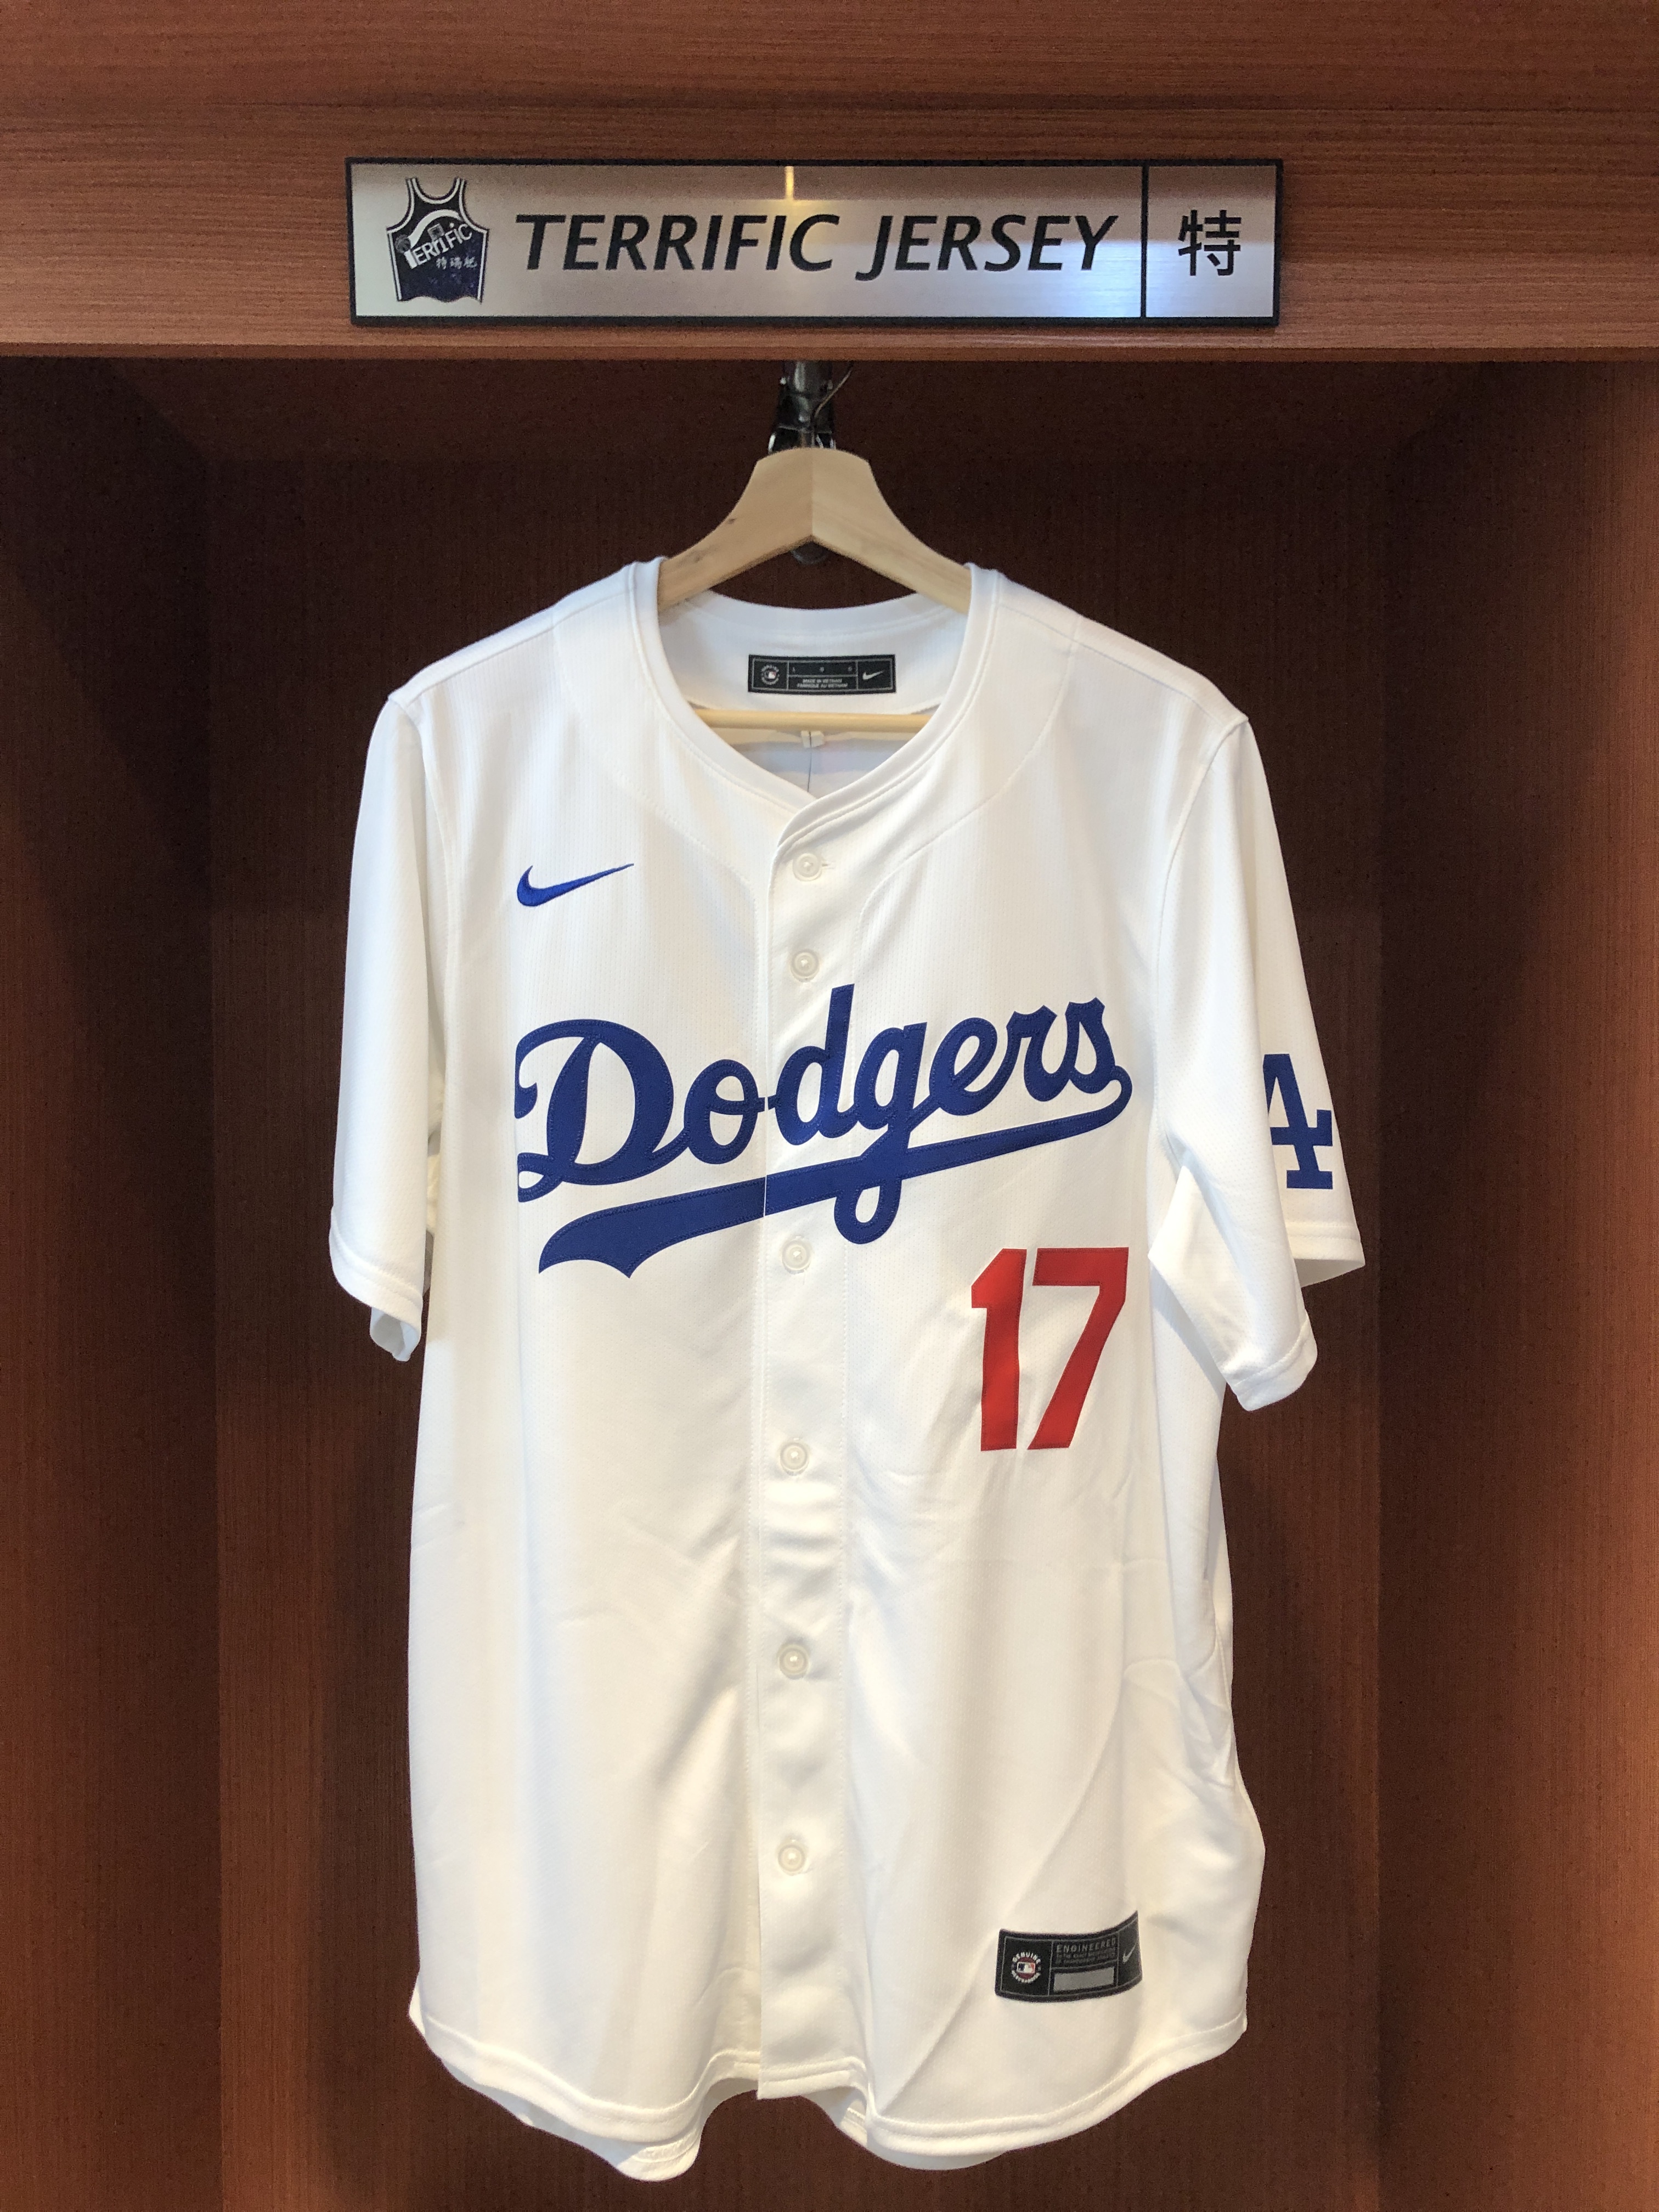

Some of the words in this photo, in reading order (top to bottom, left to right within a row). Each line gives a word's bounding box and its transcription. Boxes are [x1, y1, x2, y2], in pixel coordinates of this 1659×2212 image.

[516, 214, 840, 272] TERRIFIC
[855, 214, 1119, 281] JERSEY
[1177, 209, 1242, 276] 特
[515, 984, 1132, 1277] Dodgers
[971, 1247, 1129, 1451] 17
